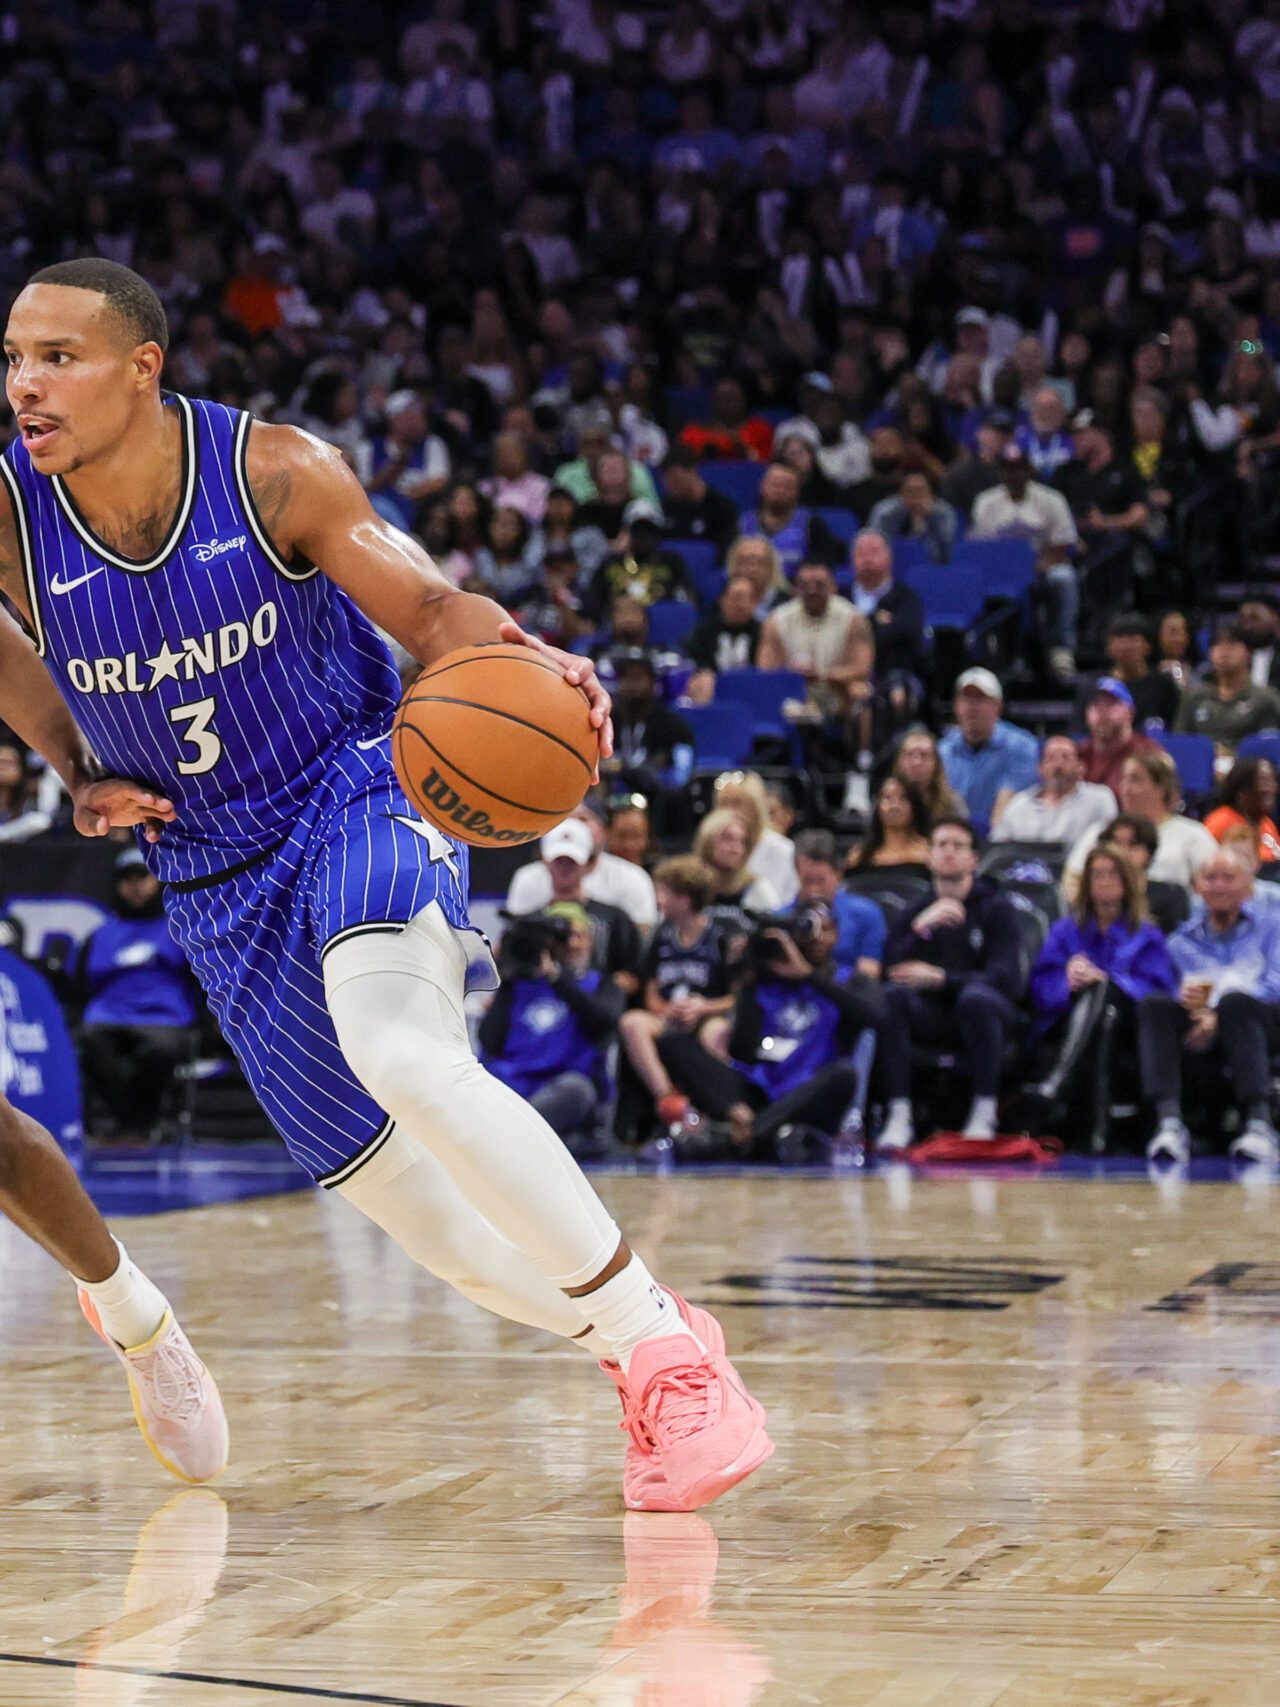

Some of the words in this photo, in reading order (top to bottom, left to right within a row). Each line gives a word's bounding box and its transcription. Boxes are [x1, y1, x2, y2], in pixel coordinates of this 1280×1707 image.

[188, 535, 246, 563] Disney
[169, 696, 221, 775] 3
[421, 767, 539, 842] Wilson
